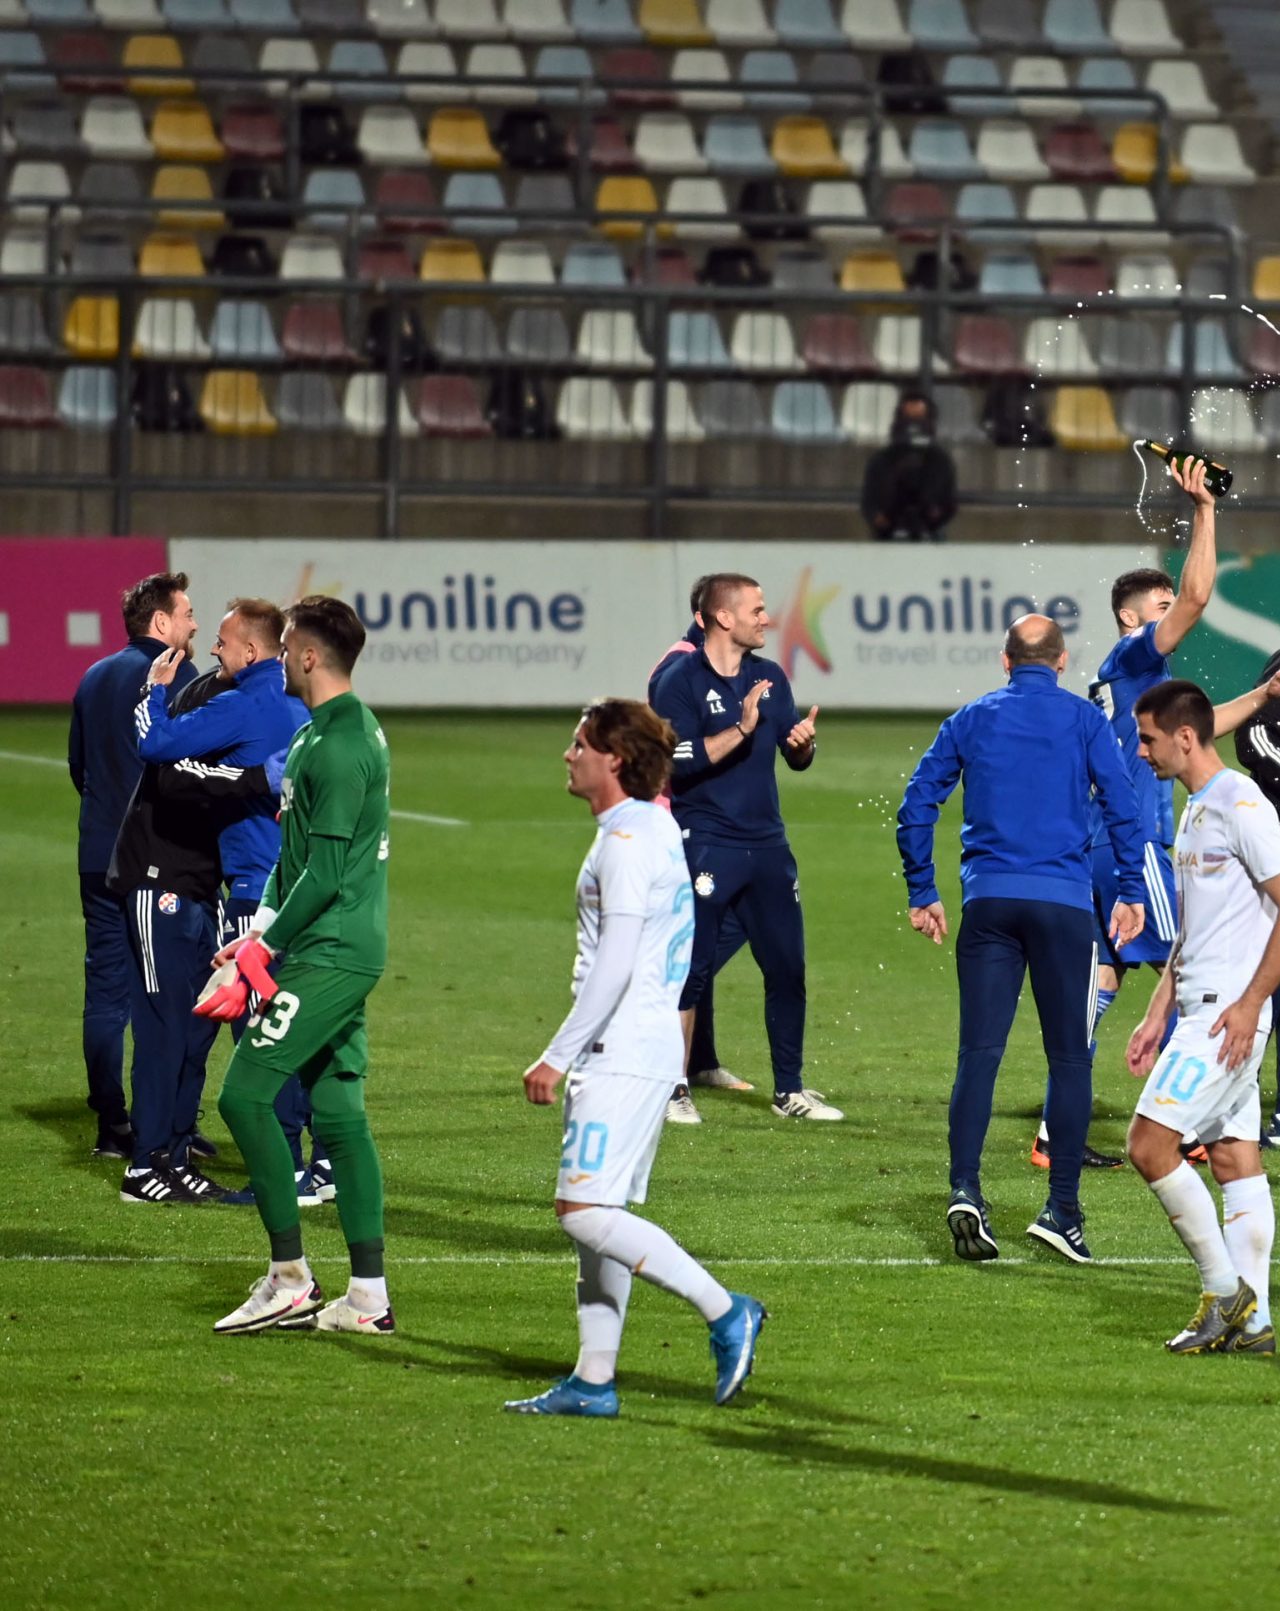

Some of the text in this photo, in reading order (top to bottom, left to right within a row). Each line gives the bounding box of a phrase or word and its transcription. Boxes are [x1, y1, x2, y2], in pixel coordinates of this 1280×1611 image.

[354, 573, 585, 632] uniline
[853, 576, 1082, 634] uniline
[361, 639, 588, 670] ravel company
[856, 642, 938, 665] travel
[1155, 1050, 1208, 1101] 10
[561, 1120, 608, 1172] 20
